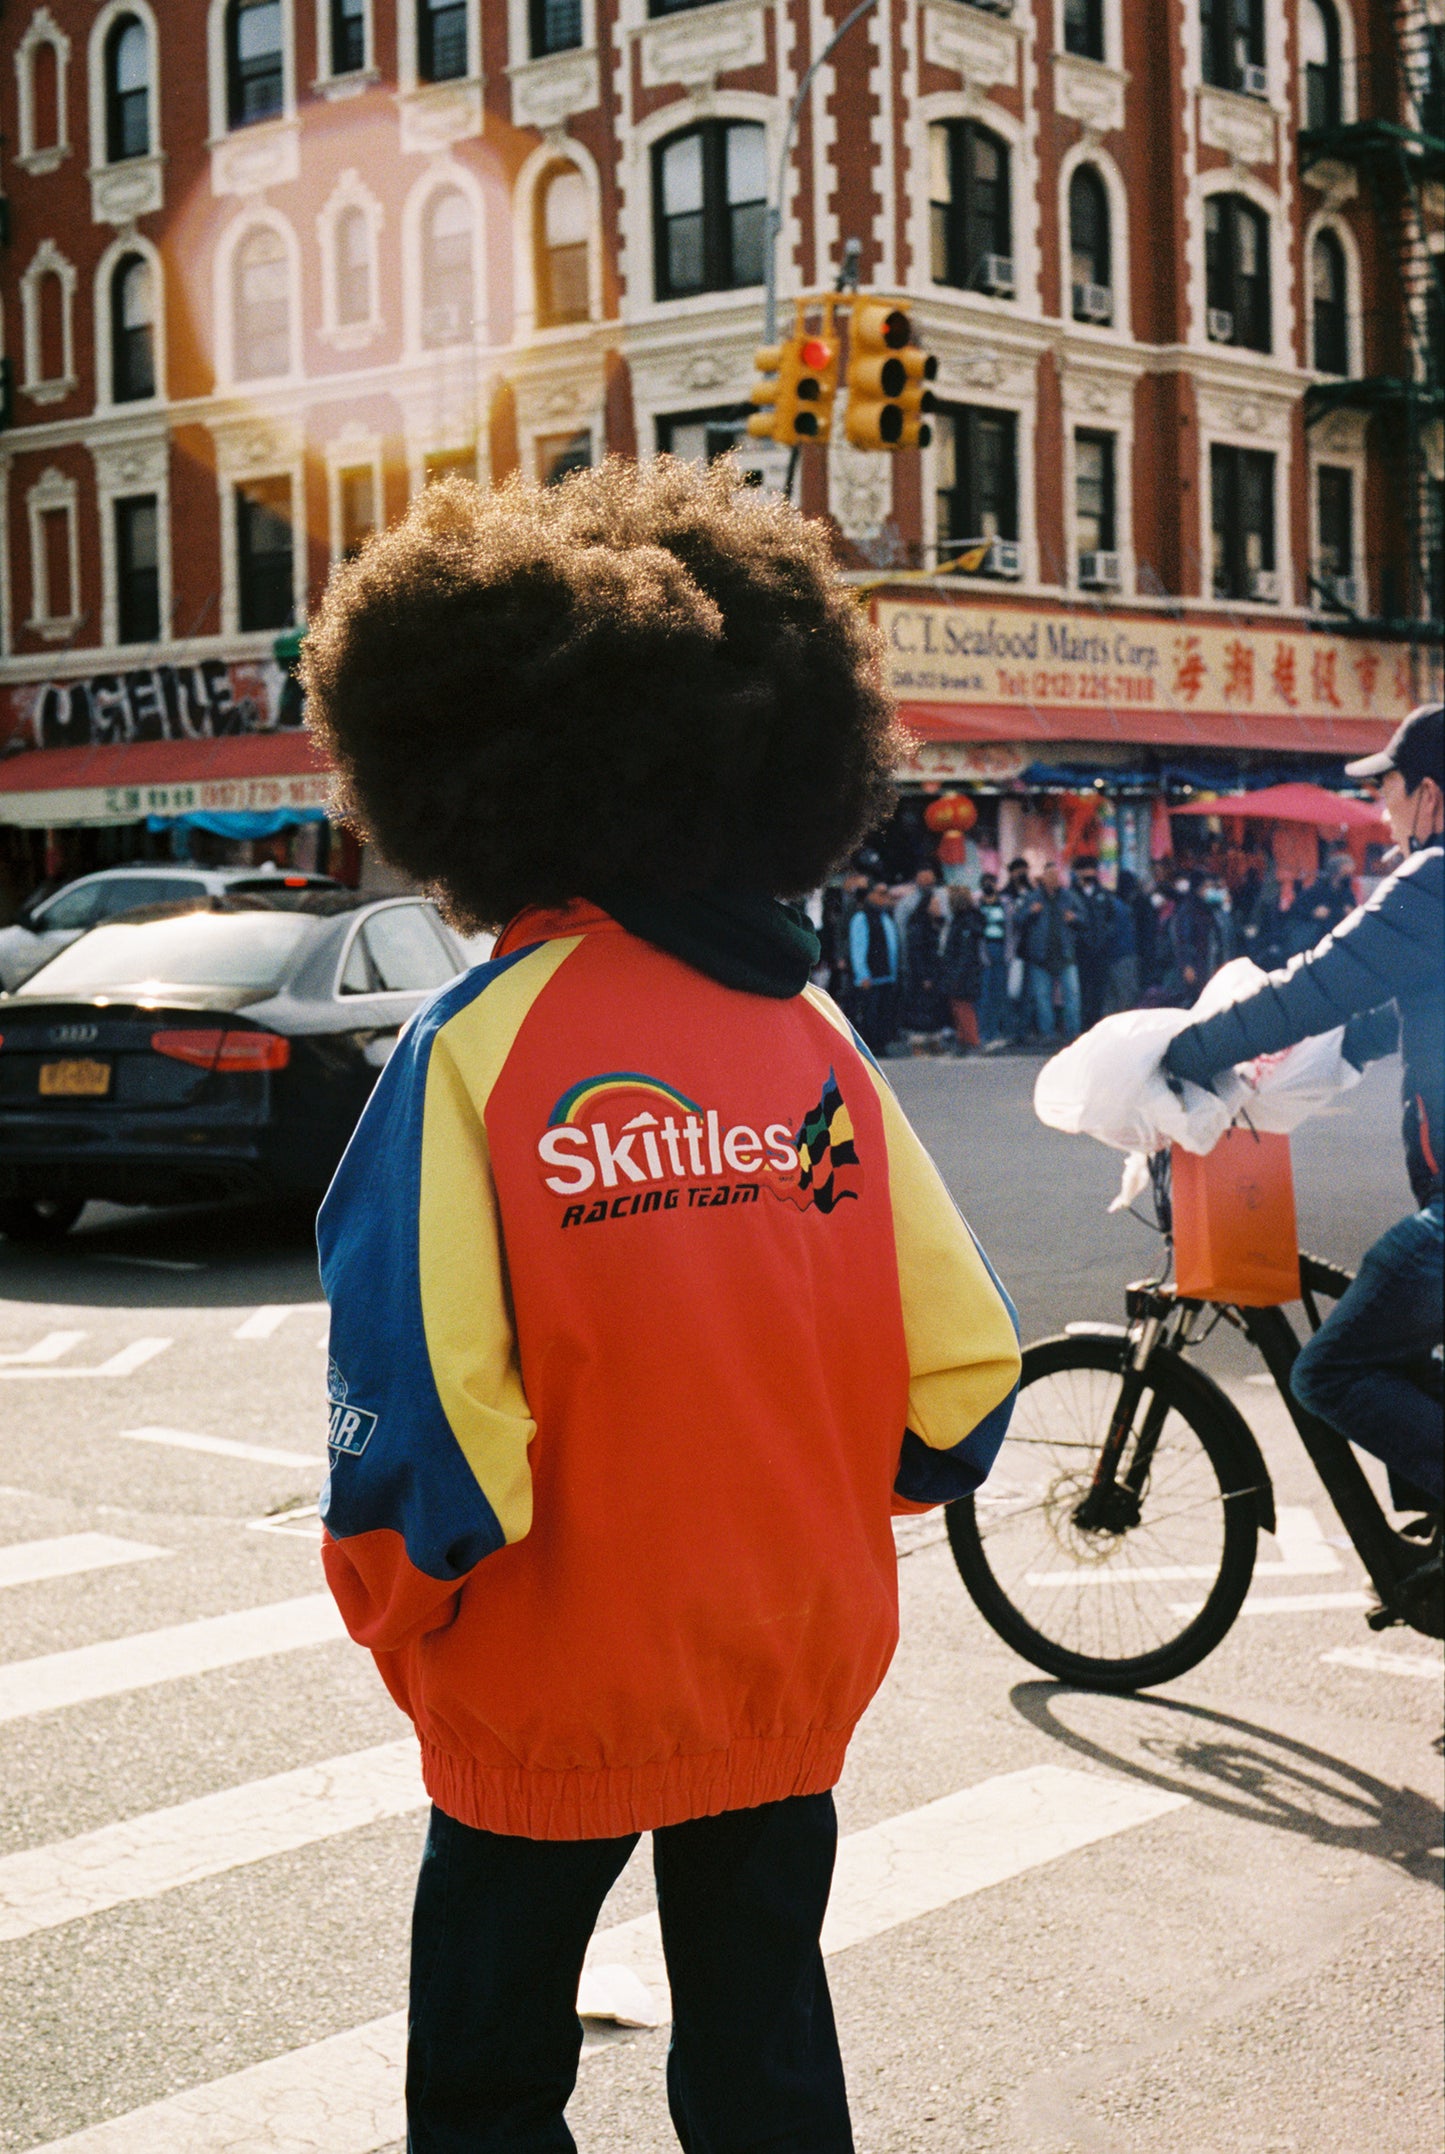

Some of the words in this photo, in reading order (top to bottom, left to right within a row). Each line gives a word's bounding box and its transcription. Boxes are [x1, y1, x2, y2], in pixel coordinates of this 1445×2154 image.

[944, 616, 1039, 660] Seafood
[538, 1110, 798, 1195] Skittles
[561, 1189, 679, 1229] RACING
[687, 1184, 759, 1208] TEAM
